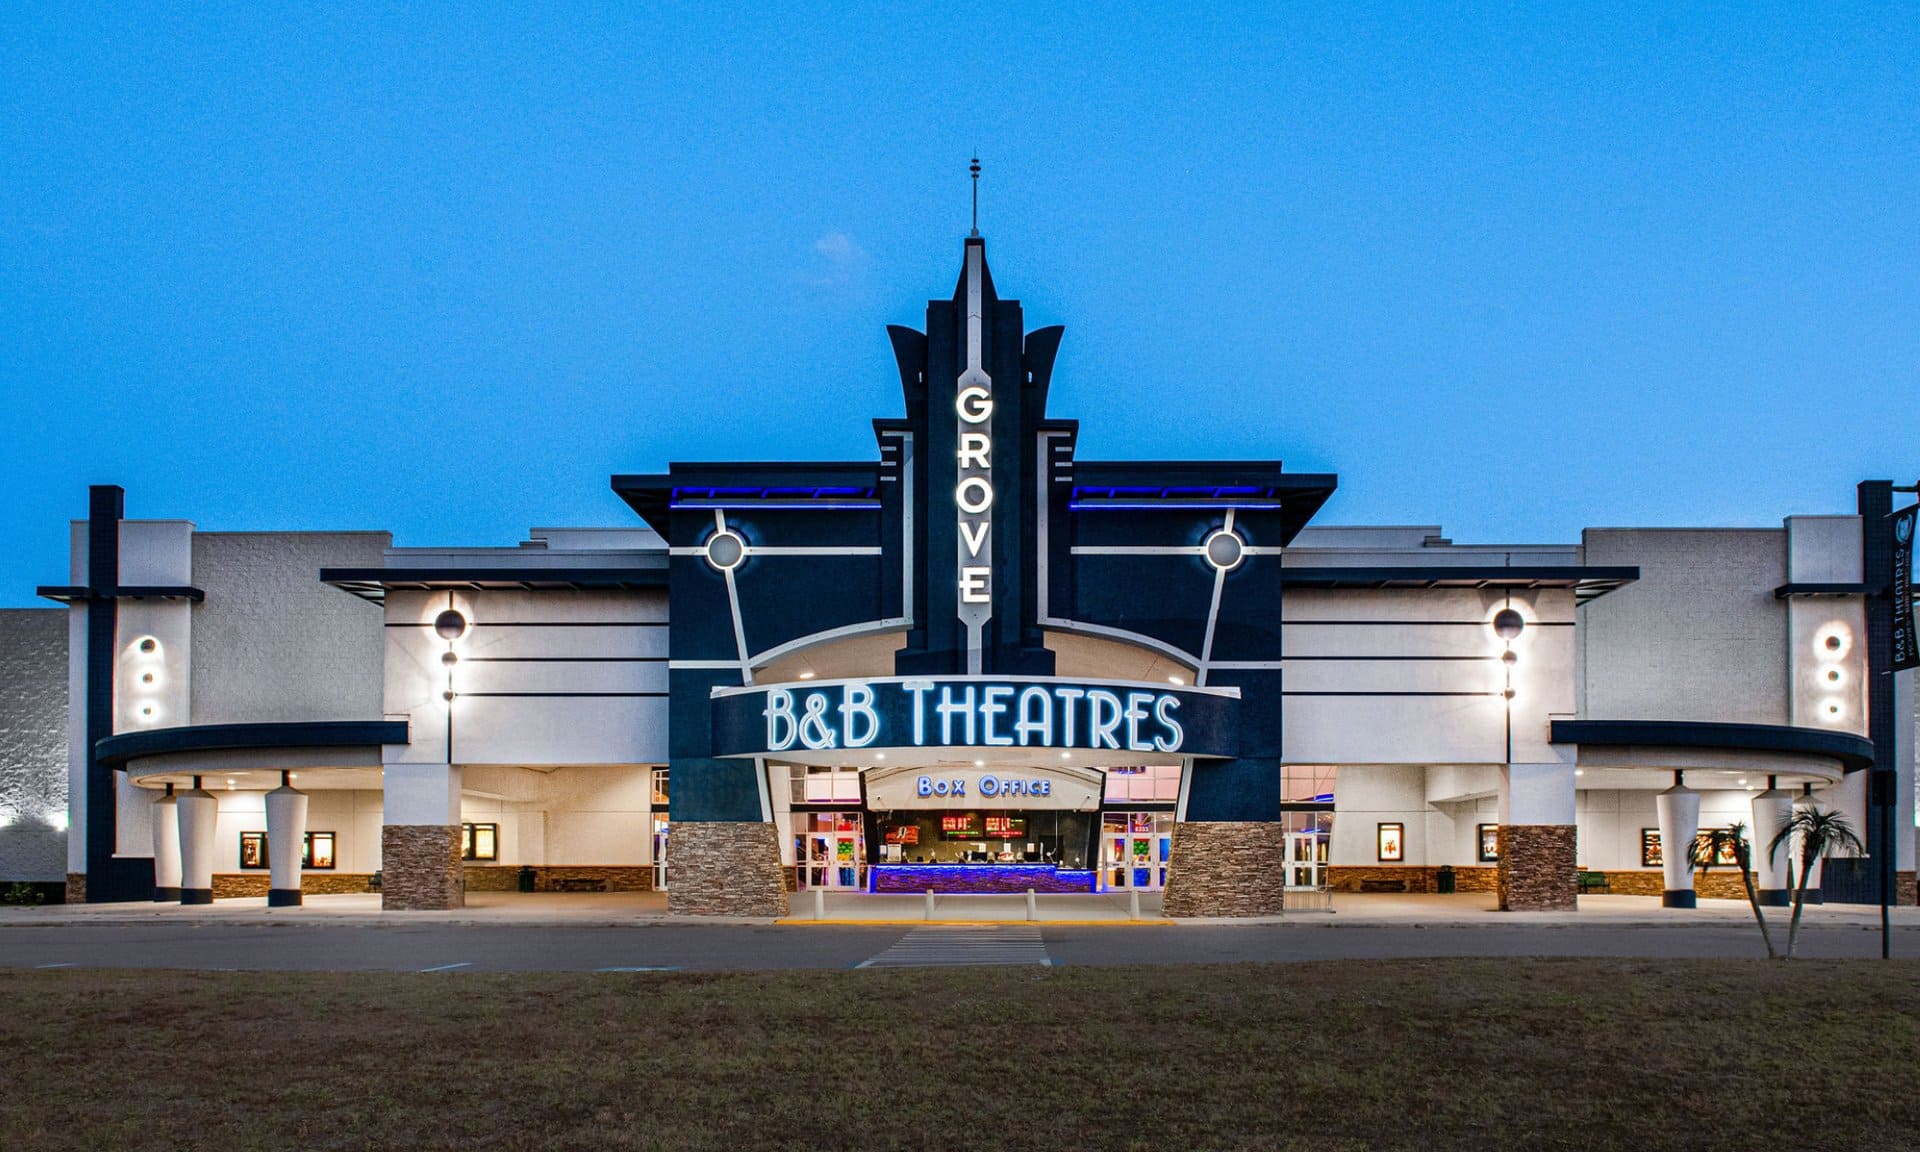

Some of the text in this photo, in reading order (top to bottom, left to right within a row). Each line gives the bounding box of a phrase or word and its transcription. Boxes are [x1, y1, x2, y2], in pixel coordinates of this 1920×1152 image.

[956, 386, 993, 603] GROVE
[1894, 549, 1905, 662] B&B THEATRES
[762, 681, 1184, 752] B&B THEATRES
[918, 775, 1051, 797] BOX OFFICE
